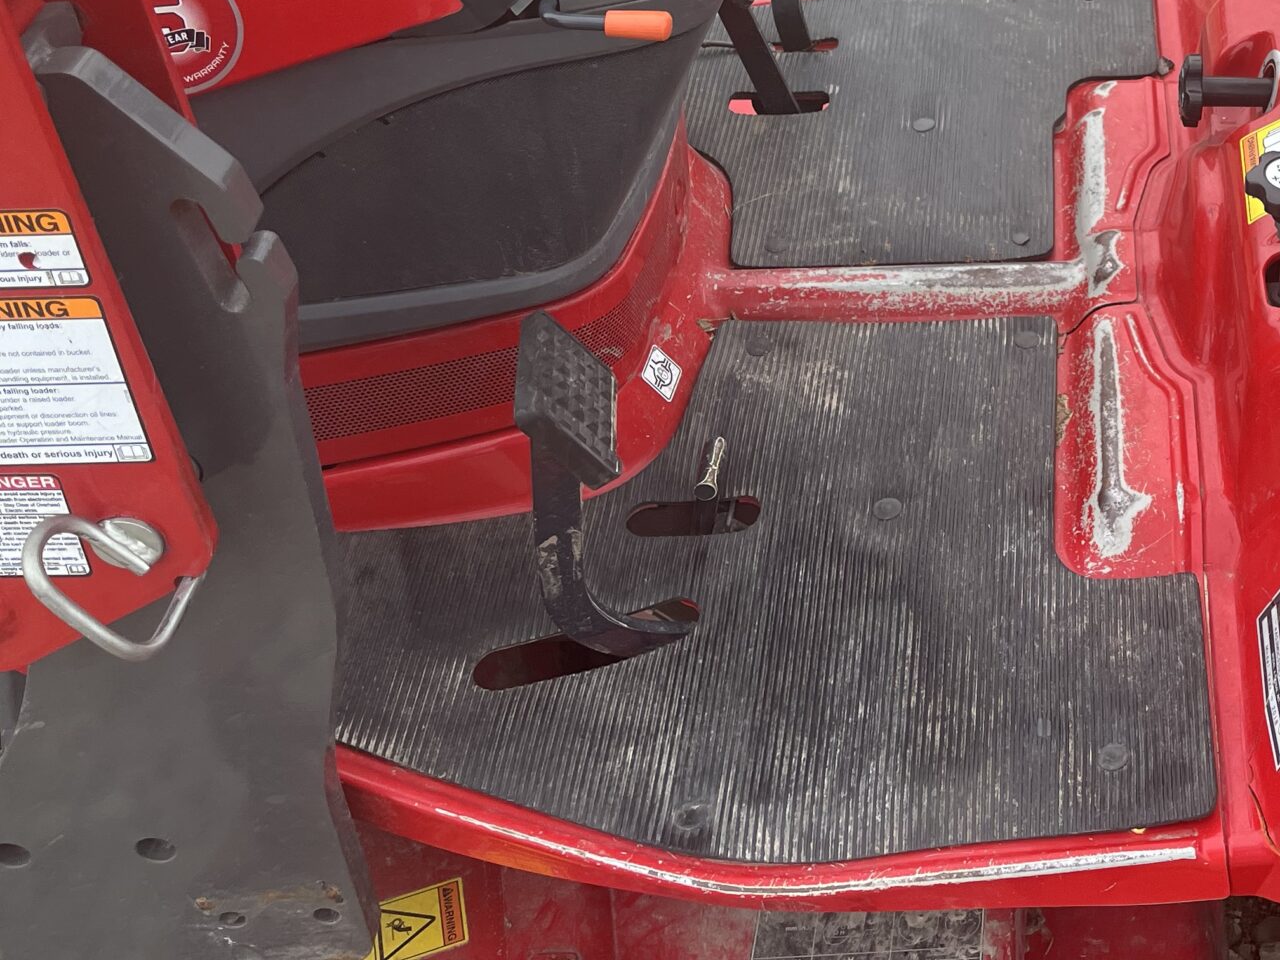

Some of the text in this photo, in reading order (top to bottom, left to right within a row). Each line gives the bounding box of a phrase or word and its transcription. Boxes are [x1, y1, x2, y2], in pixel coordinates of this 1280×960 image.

[166, 31, 189, 45] EAR
[183, 41, 230, 83] WARRANTY
[17, 274, 42, 283] injury
[8, 321, 35, 330] falling
[2, 387, 29, 396] falling
[1, 446, 113, 459] death or serious injury
[443, 897, 457, 941] WARNING
